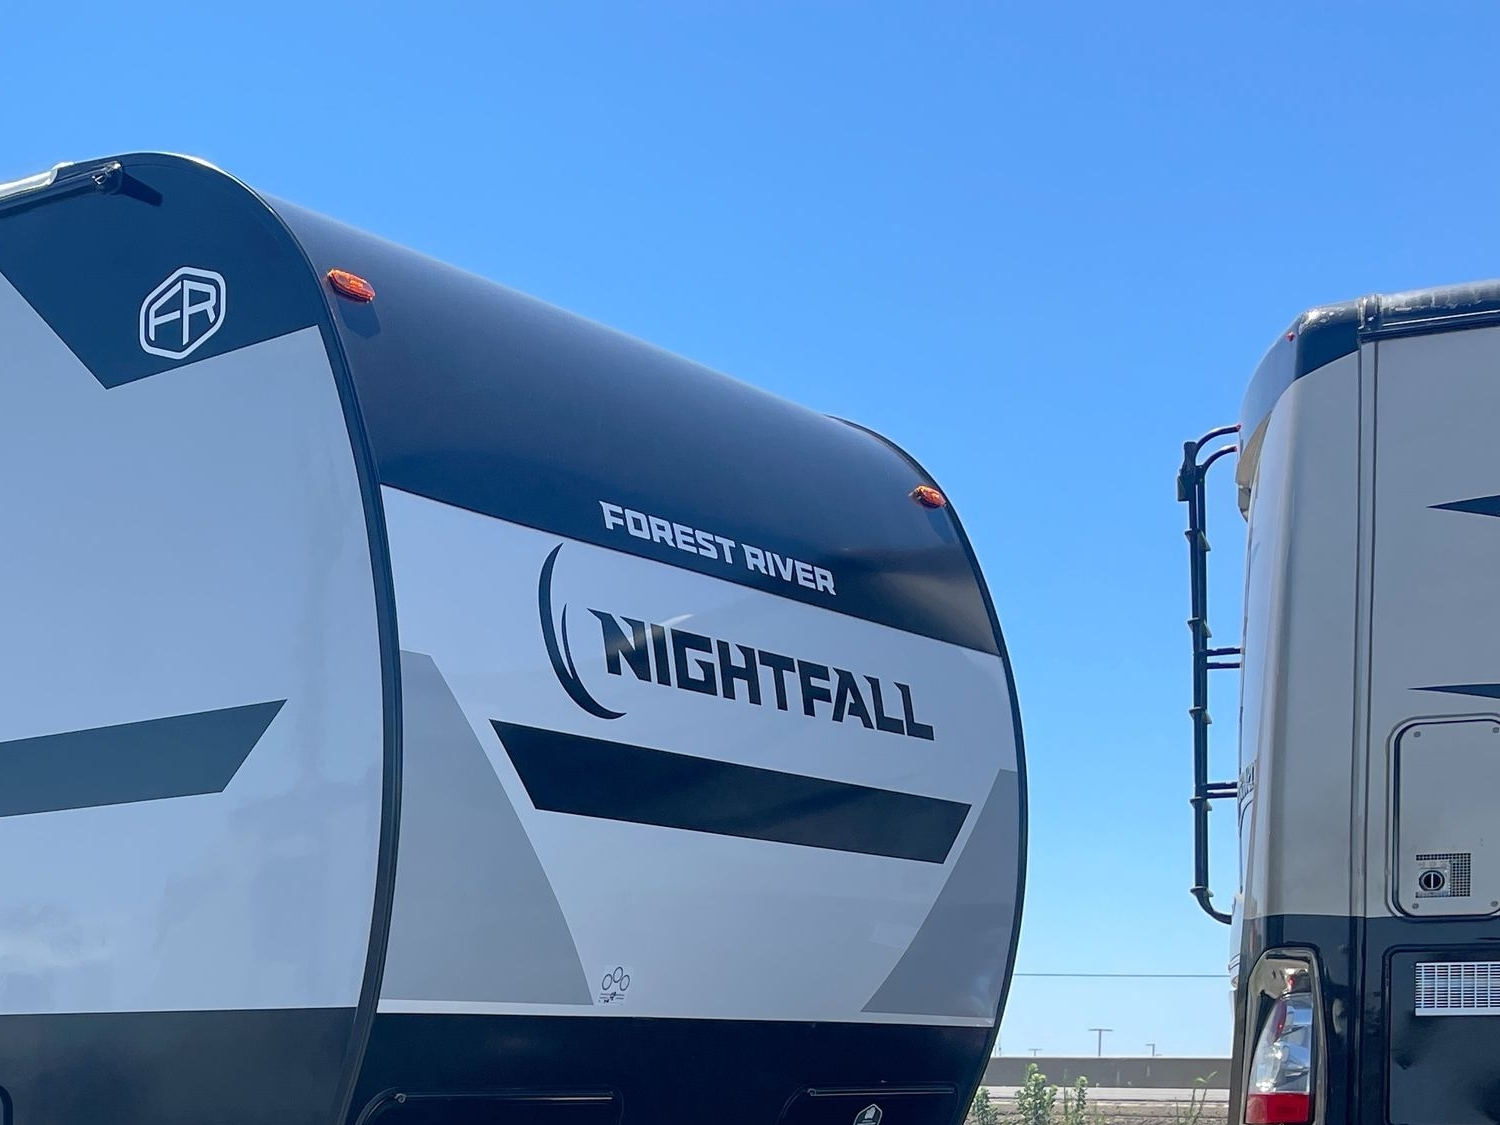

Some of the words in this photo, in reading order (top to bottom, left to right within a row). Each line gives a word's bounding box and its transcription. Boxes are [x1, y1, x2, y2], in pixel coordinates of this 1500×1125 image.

[146, 278, 218, 348] FR
[598, 500, 736, 566] FOREST
[740, 543, 838, 597] RIVER
[587, 607, 936, 742] NIGHTFALL
